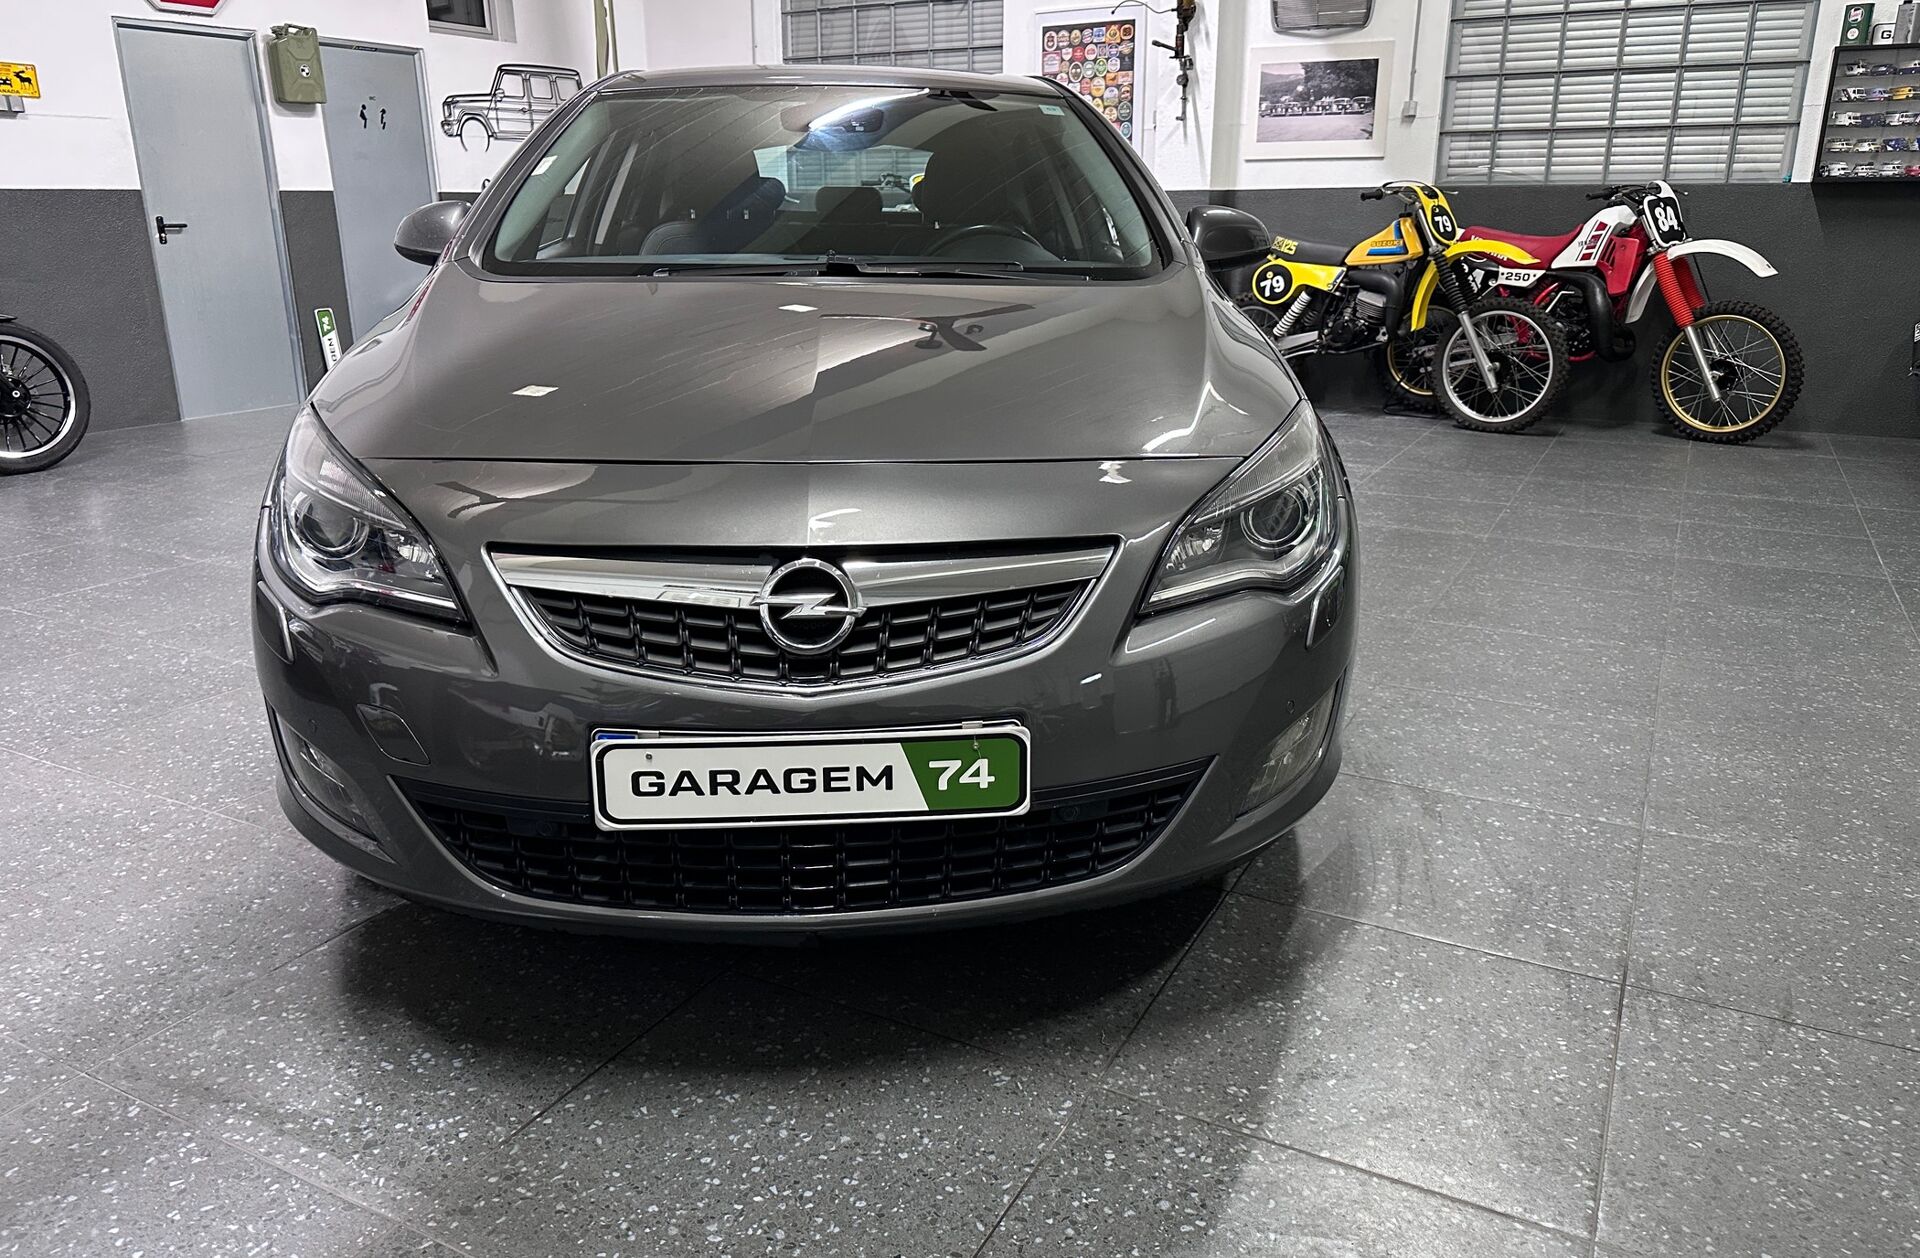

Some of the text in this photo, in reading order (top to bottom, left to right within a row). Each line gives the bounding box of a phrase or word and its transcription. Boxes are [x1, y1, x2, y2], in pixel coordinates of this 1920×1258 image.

[1434, 215, 1453, 233] 79
[1654, 206, 1679, 232] 84
[1259, 275, 1285, 298] 79
[1505, 271, 1531, 282] 250
[631, 758, 995, 797] GARAGEM 74
